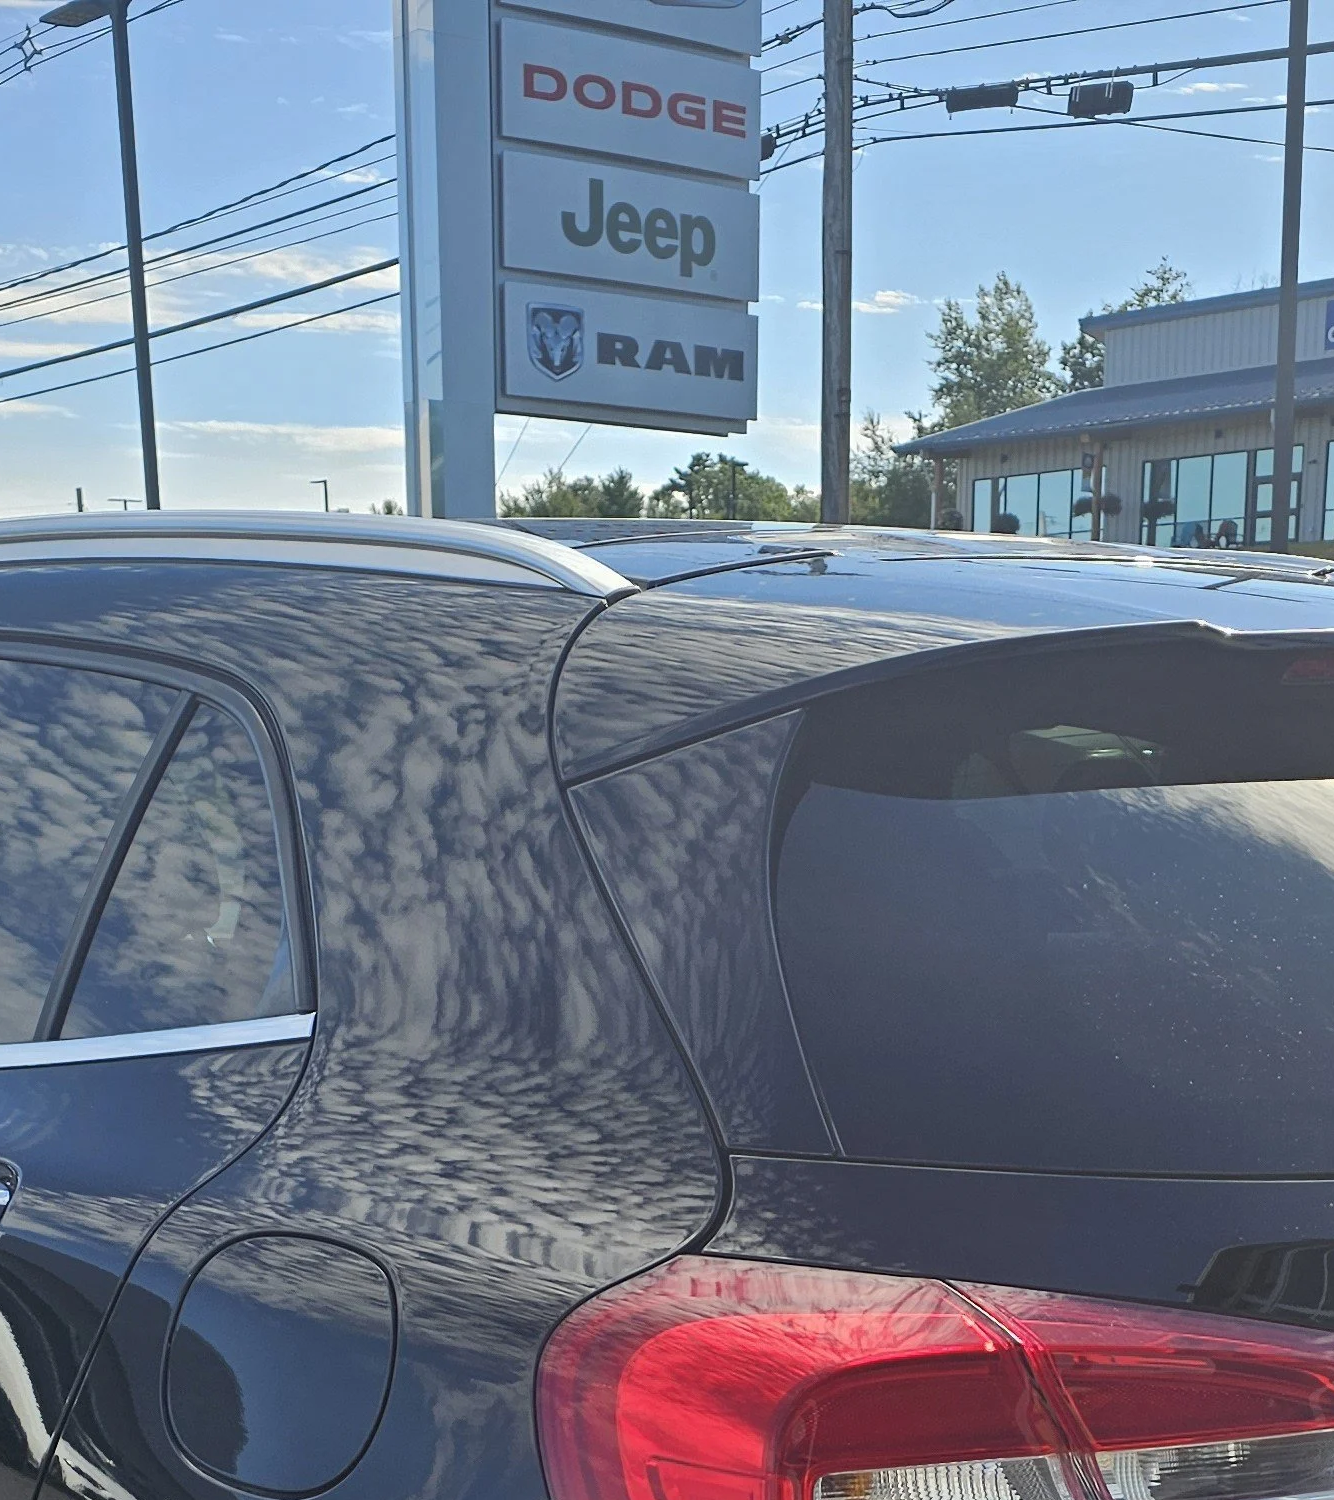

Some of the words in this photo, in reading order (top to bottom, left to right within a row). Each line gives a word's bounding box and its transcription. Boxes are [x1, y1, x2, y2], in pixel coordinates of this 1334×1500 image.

[523, 63, 746, 138] DODGE
[561, 177, 716, 278] Jeep
[596, 332, 744, 381] RAM
